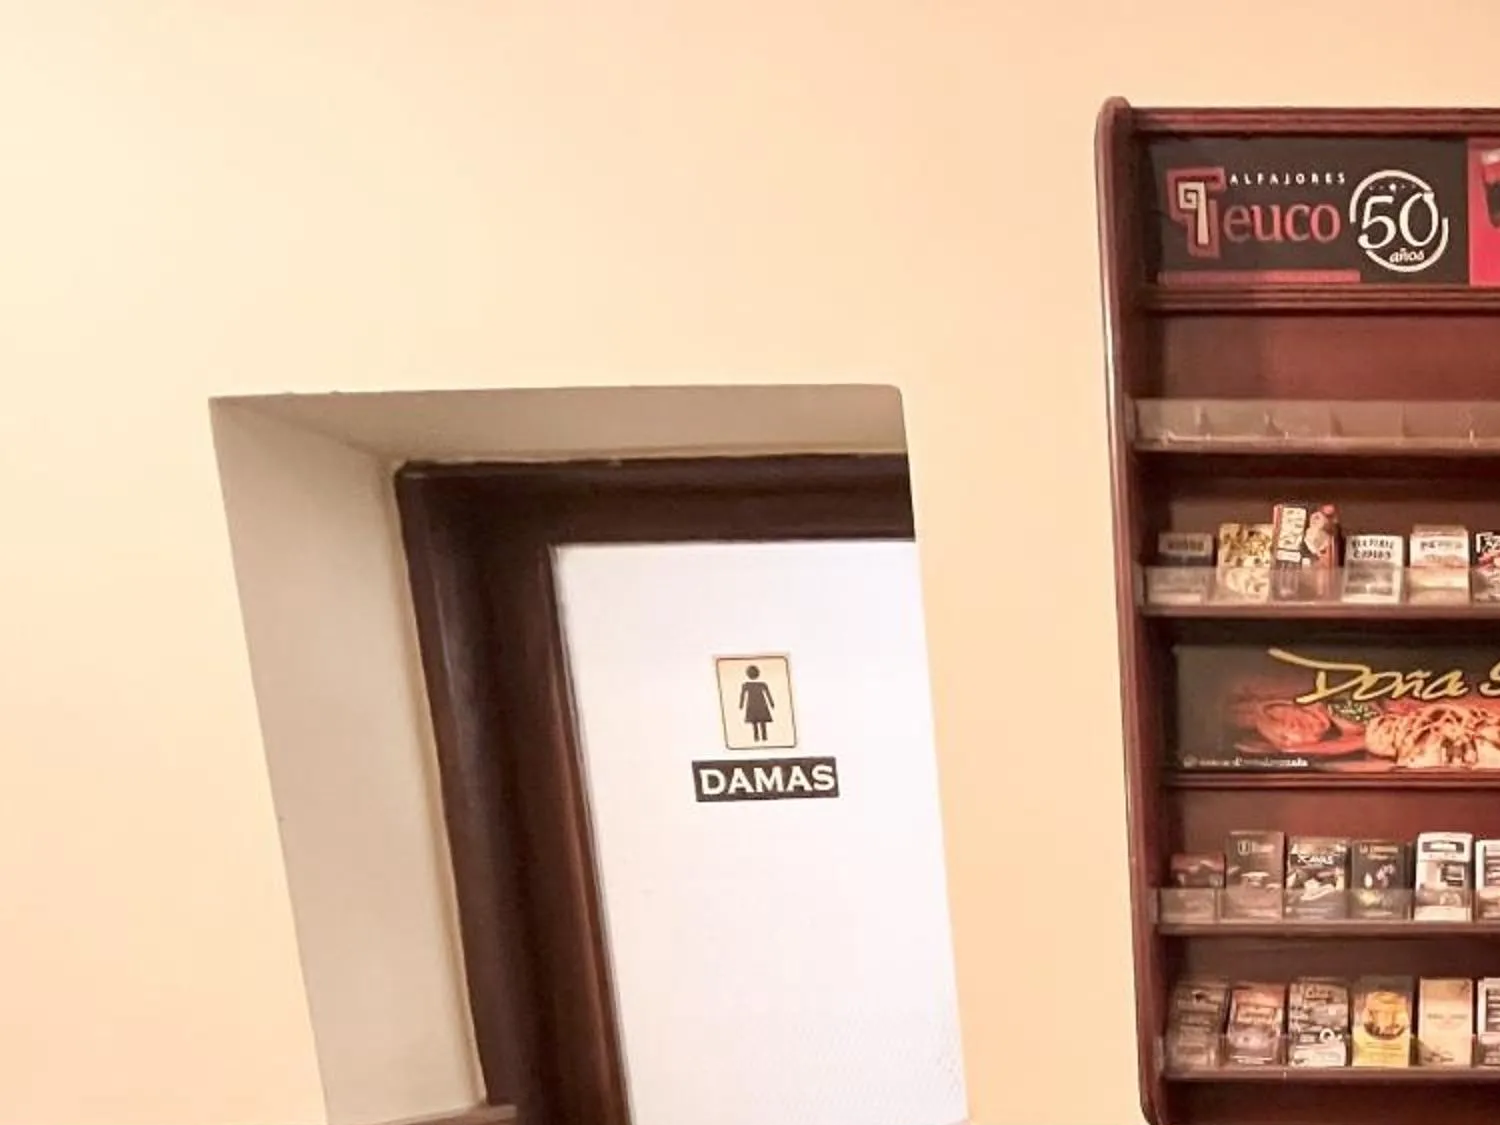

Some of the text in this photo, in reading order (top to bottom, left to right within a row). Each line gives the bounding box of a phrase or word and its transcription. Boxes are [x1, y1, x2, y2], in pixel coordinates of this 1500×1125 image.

[1230, 172, 1346, 185] ALFAJORES
[1357, 192, 1439, 250] 50
[1389, 247, 1425, 263] años
[1267, 648, 1469, 704] Doña
[699, 764, 836, 796] DAMAS
